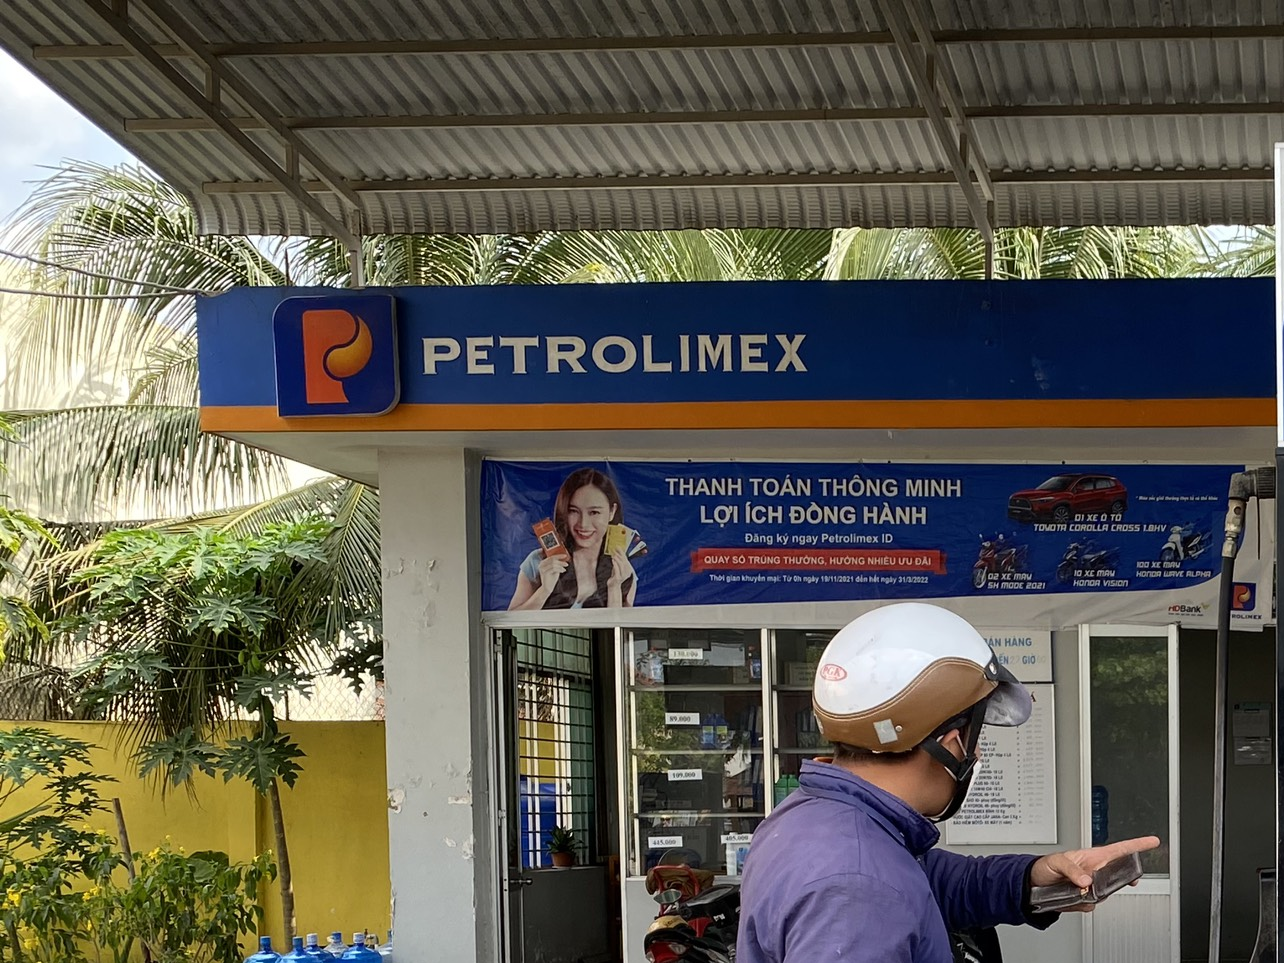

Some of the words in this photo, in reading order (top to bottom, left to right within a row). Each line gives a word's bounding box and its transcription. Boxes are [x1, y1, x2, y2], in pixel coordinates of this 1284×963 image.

[421, 333, 808, 375] PETROLIMEX
[665, 478, 742, 496] THANH
[750, 475, 811, 496] TOÁN
[818, 475, 898, 497] THÔNG
[905, 479, 962, 497] MINH
[700, 505, 739, 528] LỢI
[745, 502, 783, 524] ÍCH
[789, 502, 856, 524] ĐỒNG
[863, 503, 927, 525] HÀNH
[1033, 524, 1067, 532] TOYOTA
[1069, 524, 1109, 532] COROLLA
[1111, 524, 1141, 532] CROSS
[745, 533, 773, 545] Đăng
[776, 532, 789, 545] ký
[792, 534, 818, 545] ngay
[821, 533, 879, 543] Petrolimex
[881, 533, 893, 543] ID
[704, 556, 730, 565] QUAY
[1005, 635, 1032, 647] HÀNG
